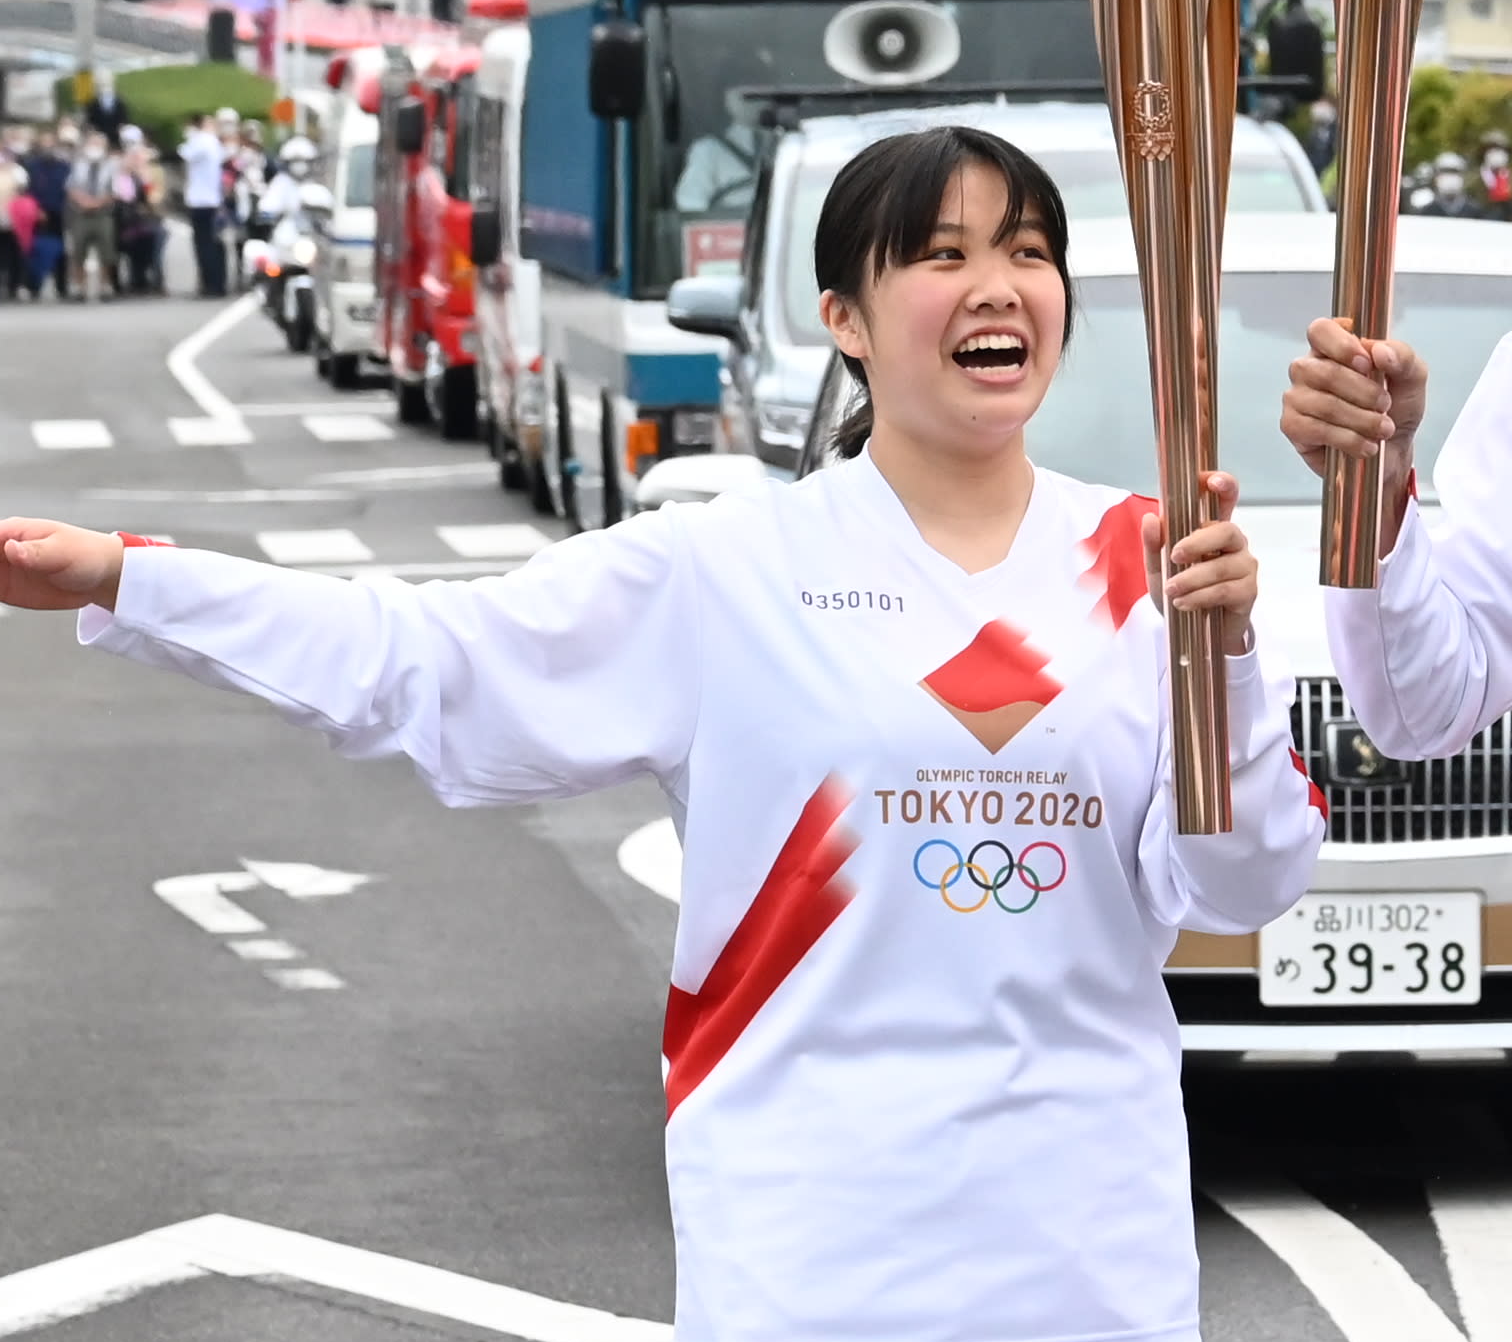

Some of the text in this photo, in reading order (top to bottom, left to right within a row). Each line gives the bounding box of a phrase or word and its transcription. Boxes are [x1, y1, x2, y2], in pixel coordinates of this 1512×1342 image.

[801, 590, 904, 613] 0350101
[916, 769, 1068, 785] OLYMPIC TORCH RELAY
[874, 789, 1104, 829] TOKYO 2020
[1312, 942, 1465, 994] 39-38
